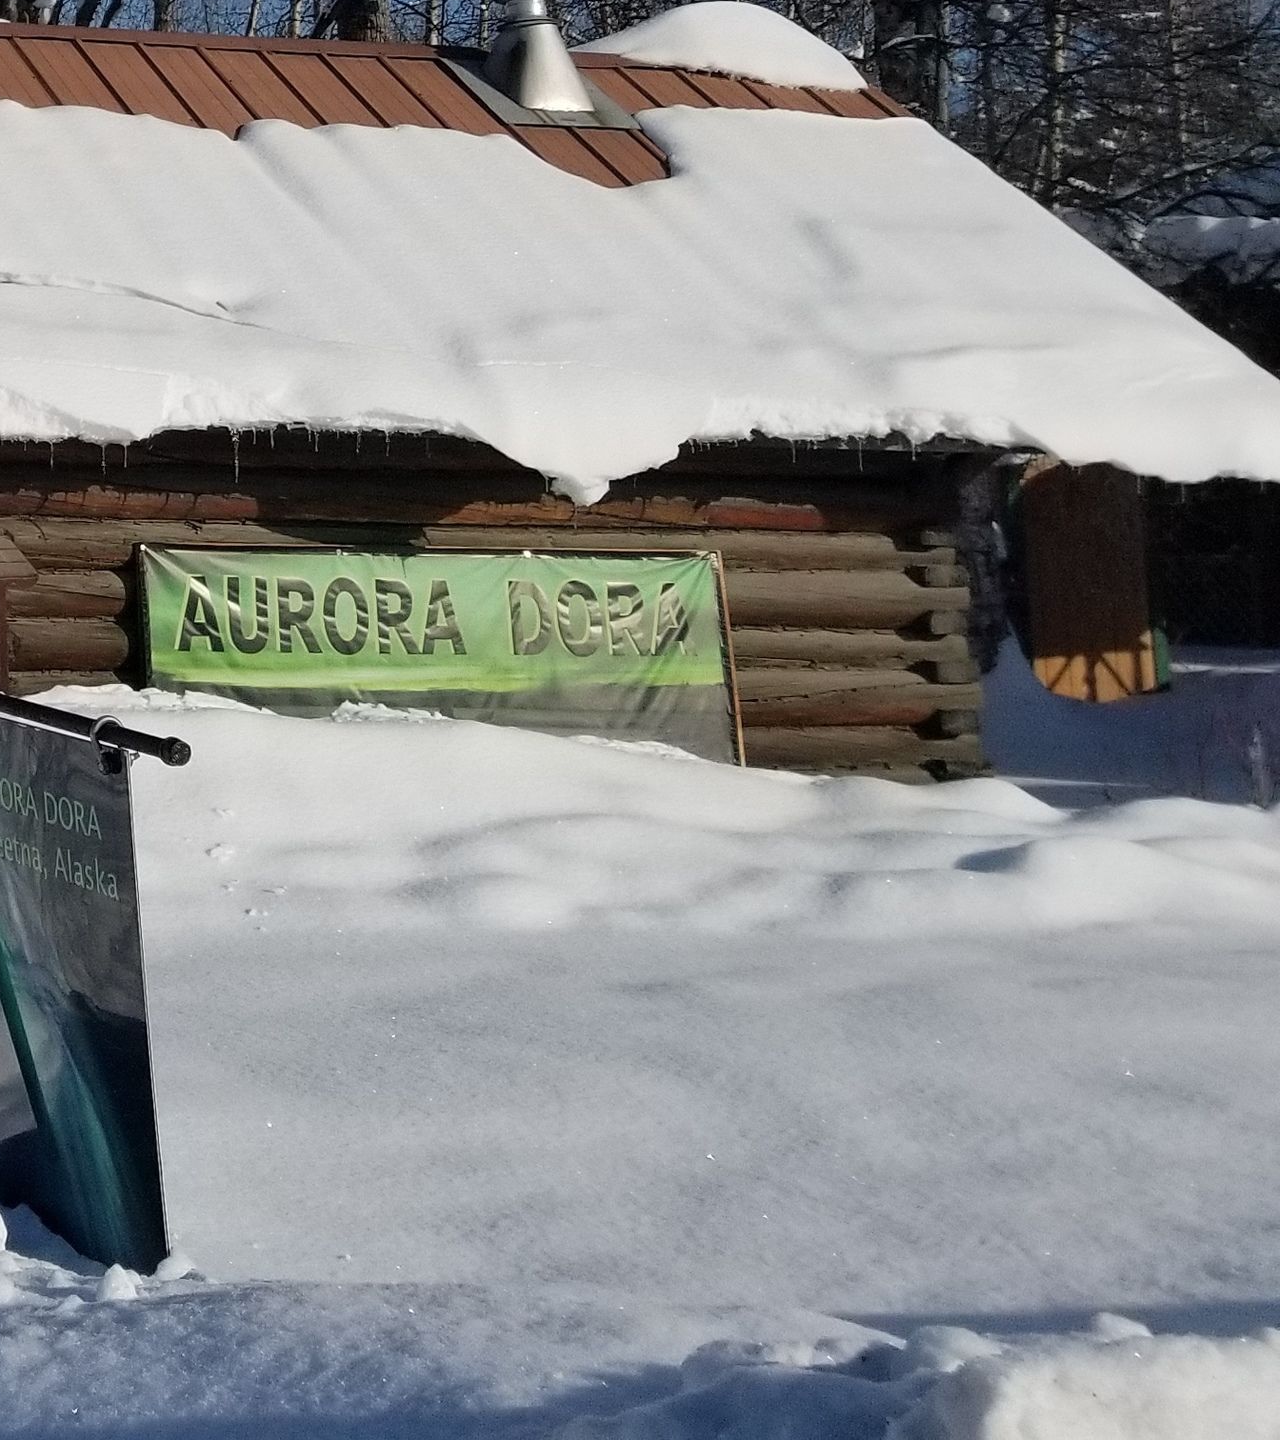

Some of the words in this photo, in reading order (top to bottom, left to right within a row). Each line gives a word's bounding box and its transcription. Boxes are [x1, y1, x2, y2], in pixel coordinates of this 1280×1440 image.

[174, 574, 467, 656] AURORA
[508, 579, 698, 657] DORA
[43, 791, 102, 840] DORA
[55, 847, 119, 901] Alaska
